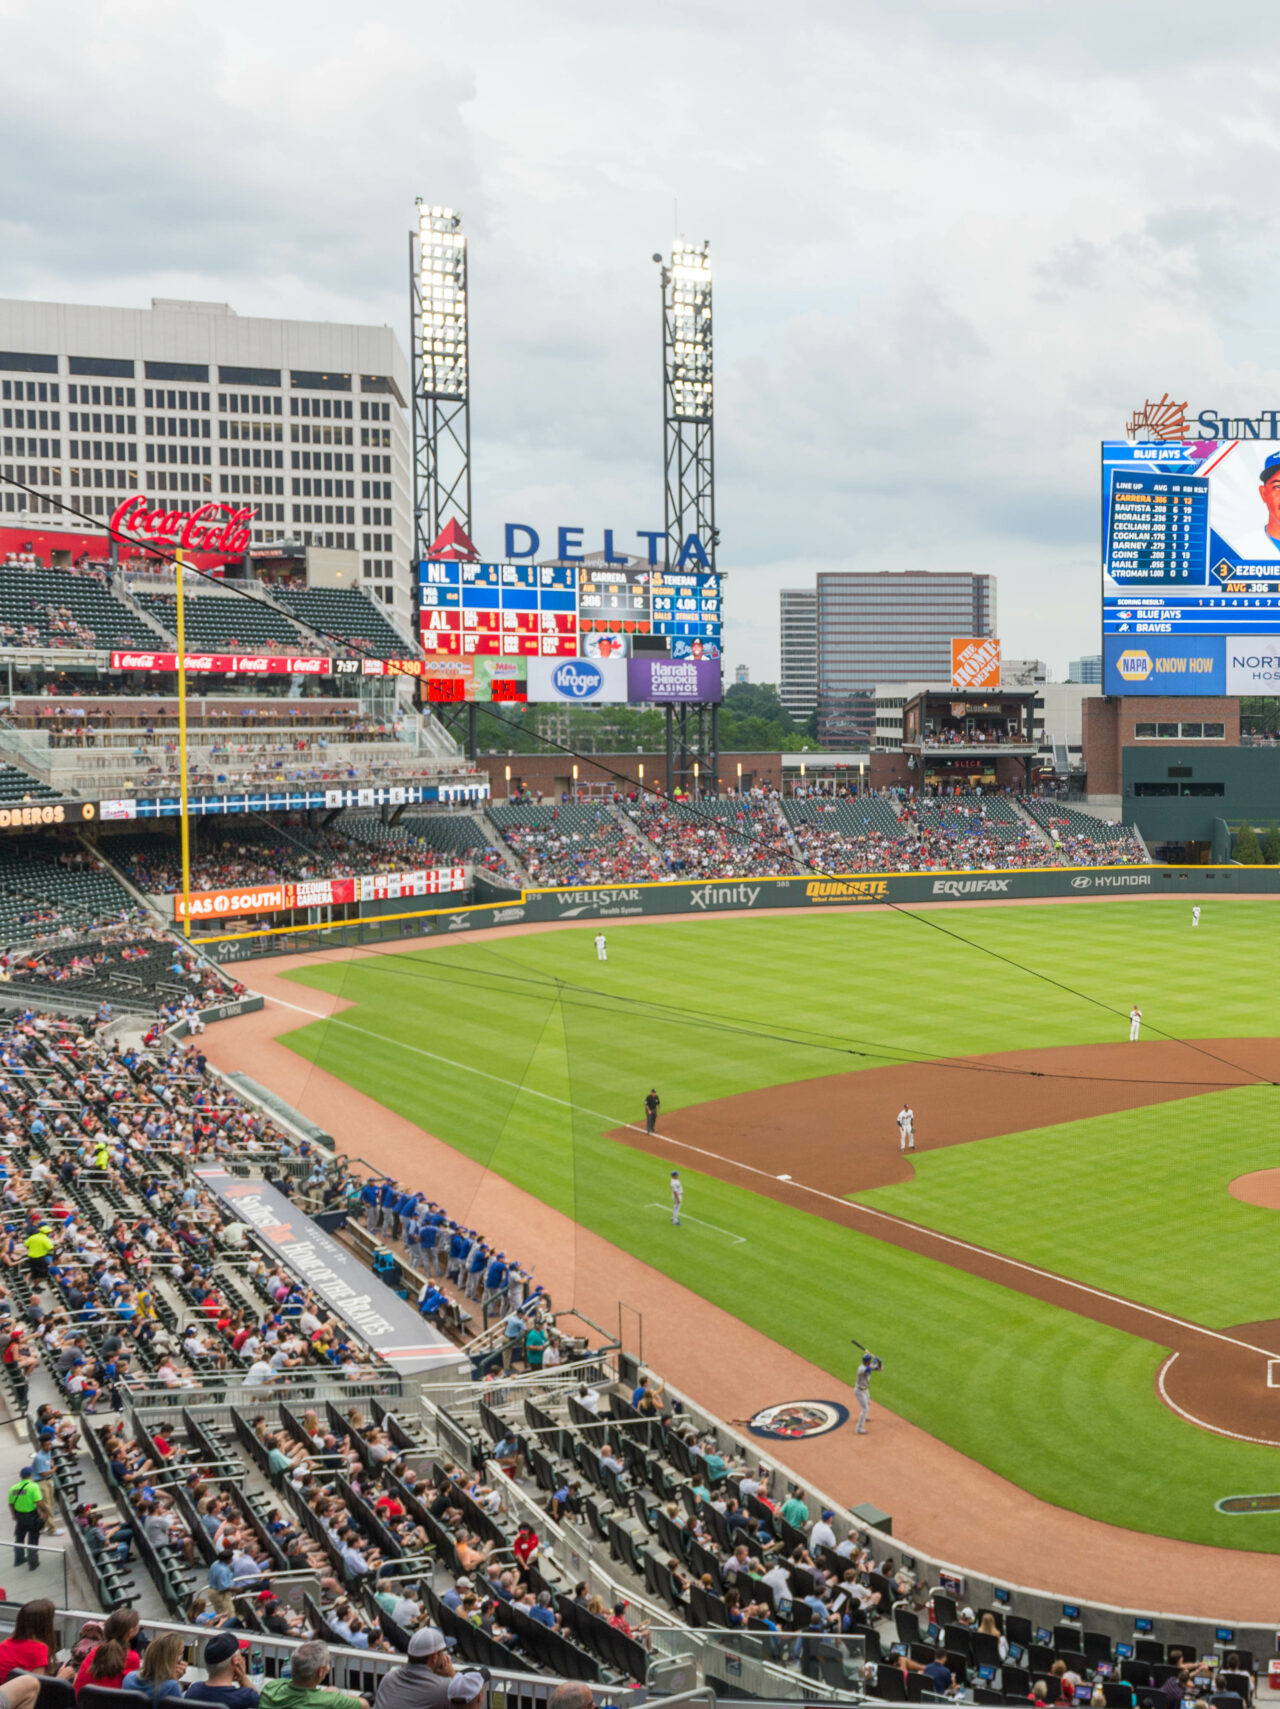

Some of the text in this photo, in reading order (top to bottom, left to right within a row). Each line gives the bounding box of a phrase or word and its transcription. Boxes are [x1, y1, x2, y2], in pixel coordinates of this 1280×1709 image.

[1134, 450, 1180, 460] BLUE JAYS
[1115, 494, 1151, 502] CARRERA
[1115, 504, 1151, 512] BAUTISTA
[110, 495, 259, 553] Coca-Cola
[504, 522, 711, 568] DELTA
[428, 563, 450, 583] NL
[591, 572, 627, 583] CARRERA
[1220, 566, 1228, 576] 3
[663, 575, 697, 586] TEHERAN
[1226, 584, 1246, 592] AVG
[1248, 584, 1268, 592] .306
[611, 596, 644, 608] 3 12
[655, 598, 671, 609] 3-3
[701, 600, 717, 611] 1.47
[429, 612, 451, 630] AL
[1161, 611, 1181, 619] JAYS
[706, 624, 713, 635] 2
[957, 643, 977, 662] THE
[122, 655, 154, 668] Coca-Cola
[336, 660, 359, 672] 7:37
[651, 662, 697, 675] Harrah's
[952, 639, 1000, 687] HOME
[1123, 657, 1148, 673] NAPA
[1155, 657, 1214, 673] KNOW HOW
[971, 656, 1000, 687] DEPOT
[557, 665, 600, 696] Kroger
[806, 880, 888, 896] QUIKRETE
[932, 880, 1010, 896] EQUIFAX
[1095, 875, 1150, 887] HYUNDAI
[287, 882, 332, 896] 3 EZEQUIEL
[179, 892, 281, 914] GAS SOUTH
[286, 893, 333, 907] LF CARRERA
[557, 889, 639, 905] WELLSTAR
[690, 885, 761, 909] xfinity
[280, 1241, 395, 1336] HOME OF THE BRAVES
